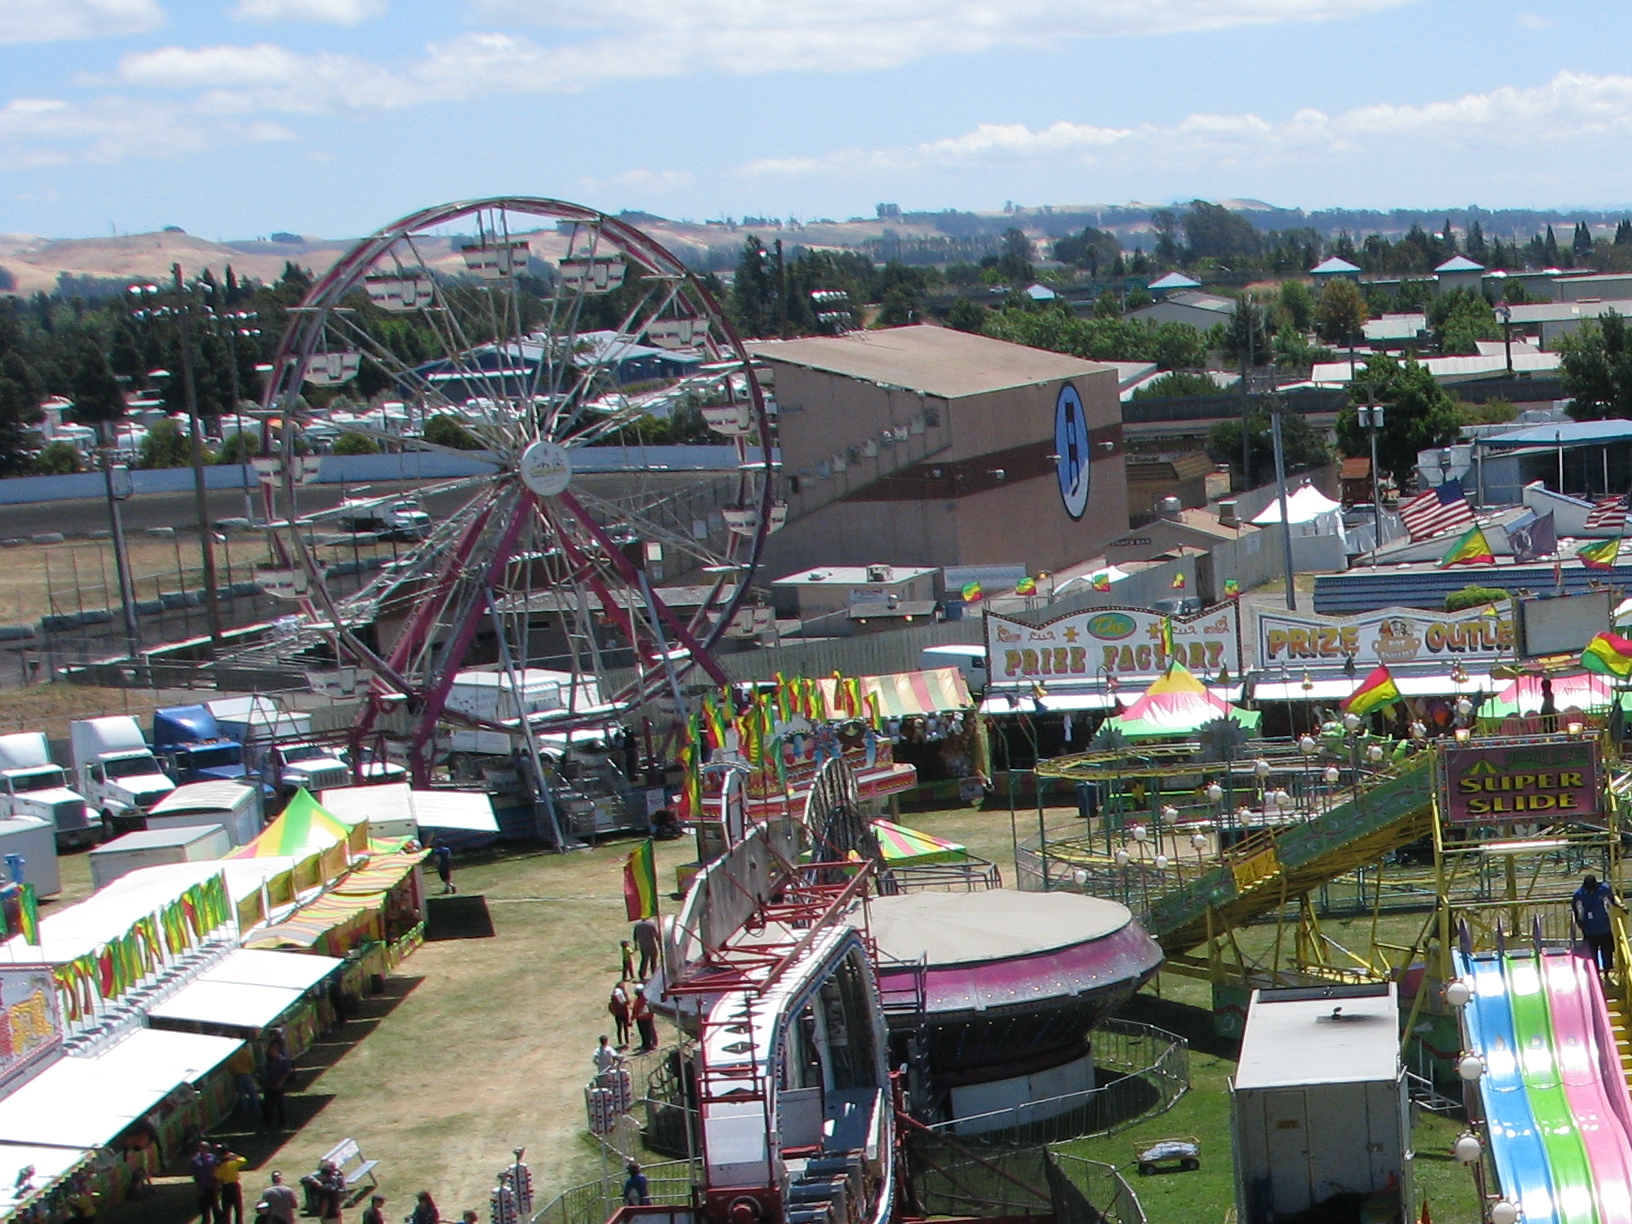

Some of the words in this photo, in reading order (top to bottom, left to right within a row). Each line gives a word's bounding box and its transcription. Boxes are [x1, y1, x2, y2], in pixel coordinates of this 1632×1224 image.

[1267, 627, 1360, 660] PRIZE
[1425, 620, 1515, 652] OUTLE
[1005, 646, 1086, 677] PRIZE
[1458, 771, 1584, 794] SUPER
[1467, 792, 1579, 814] SLIDE
